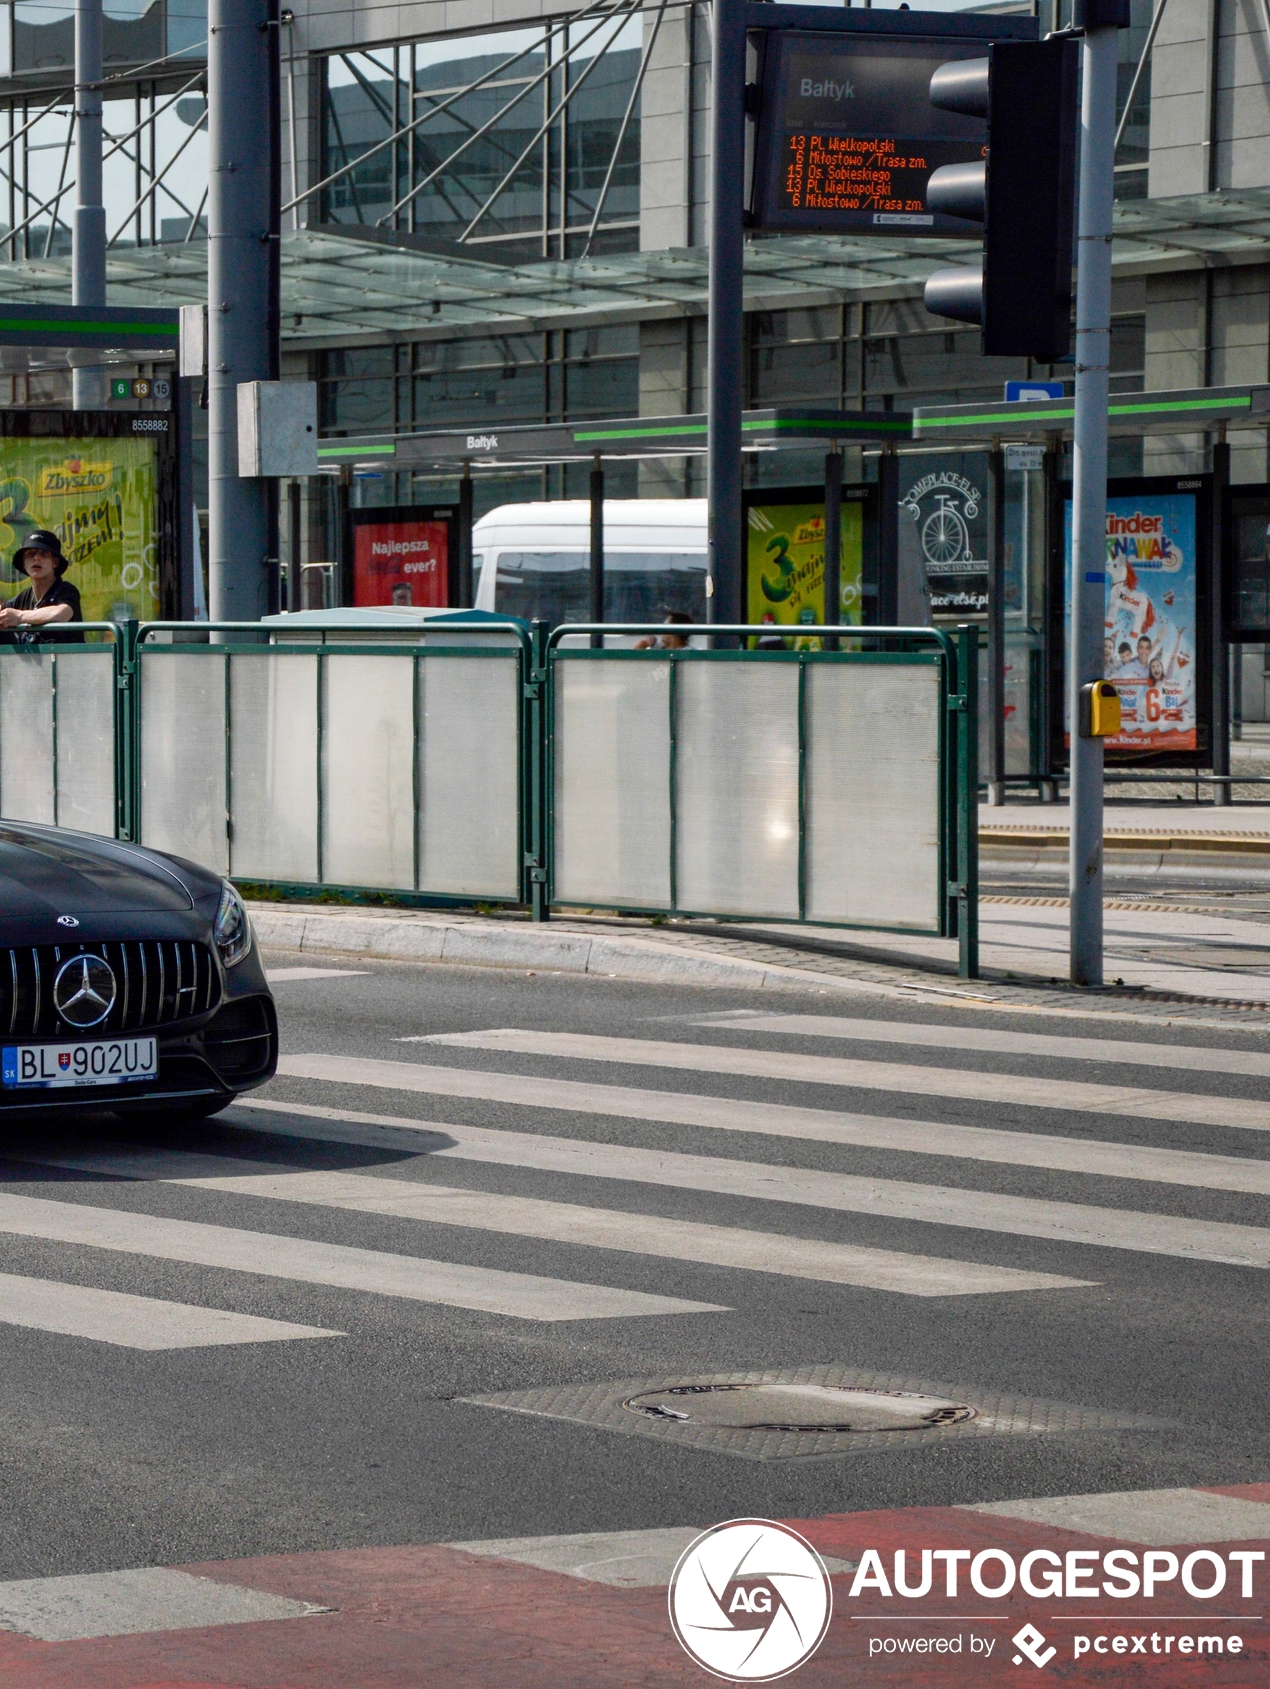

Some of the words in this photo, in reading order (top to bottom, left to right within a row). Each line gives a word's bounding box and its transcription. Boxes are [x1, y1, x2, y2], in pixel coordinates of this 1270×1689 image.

[800, 78, 855, 100] Bałtyk
[790, 135, 806, 150] 13
[810, 136, 825, 151] Pl.
[828, 137, 896, 153] Wielkopolski
[796, 150, 804, 164] 6
[809, 150, 863, 166] Miłostowo
[909, 157, 927, 169] zm.
[788, 164, 803, 178] 15
[808, 166, 824, 179] Os.
[828, 167, 891, 182] Sobieskiego
[786, 179, 802, 193] 13
[806, 180, 822, 194] Pl.
[825, 180, 892, 196] Wielkopolski
[792, 193, 800, 207] 6
[805, 193, 860, 209] Miłostowo
[905, 199, 924, 211] zm.
[117, 384, 125, 394] 6
[135, 383, 148, 394] 13
[155, 384, 168, 394] 15
[132, 420, 169, 431] 8558882
[467, 435, 498, 451] Bałtyk
[45, 470, 106, 491] Zbyszko
[1105, 513, 1162, 535] inder
[372, 540, 430, 557] Najlepsza
[403, 559, 437, 574] ever?
[760, 531, 797, 603] 3
[1145, 688, 1161, 722] 6
[4, 1069, 16, 1079] SK
[21, 1048, 57, 1080] BL
[72, 1040, 154, 1077] 902UJ
